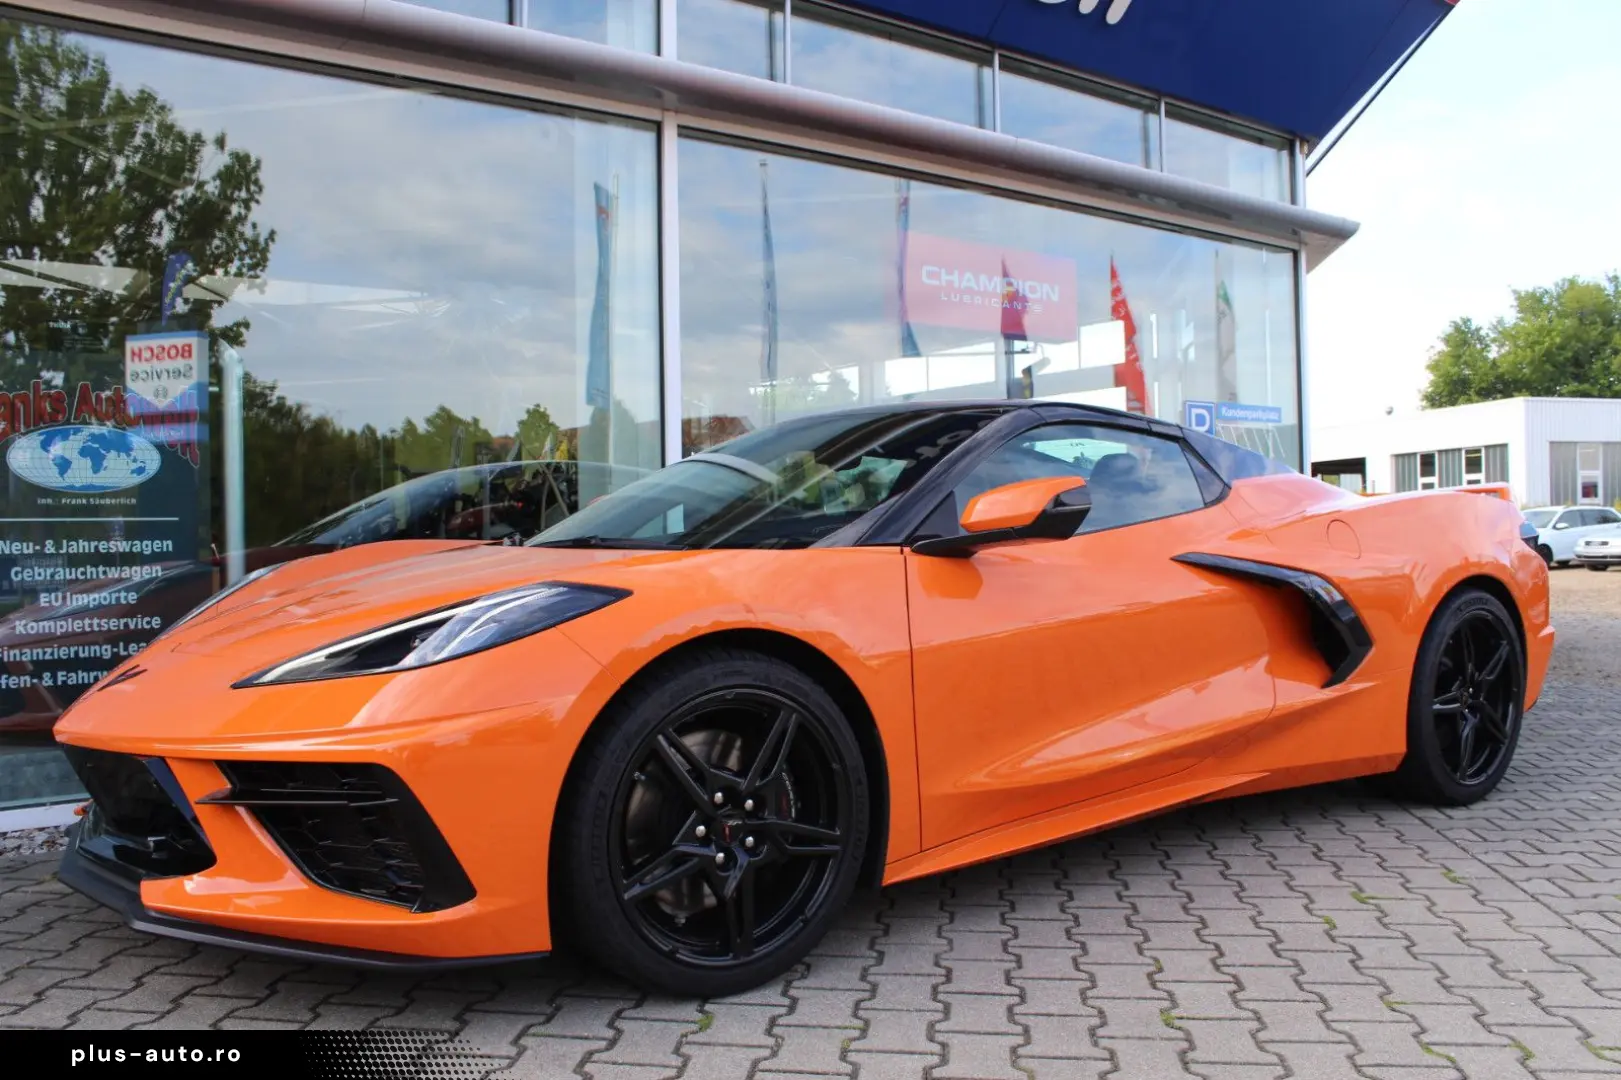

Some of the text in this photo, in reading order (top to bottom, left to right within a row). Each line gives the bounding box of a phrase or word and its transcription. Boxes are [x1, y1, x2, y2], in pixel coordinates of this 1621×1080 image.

[921, 264, 1060, 303] CHAMPION
[940, 291, 1043, 313] LUBRICANTS
[61, 497, 87, 505] Frank
[0, 538, 173, 556] Neu- & Jahreswagen
[10, 564, 162, 582] Gebrauchtwagen
[40, 590, 138, 607] EU Importe
[15, 614, 162, 636] Komplettservice
[42, 671, 54, 687] &
